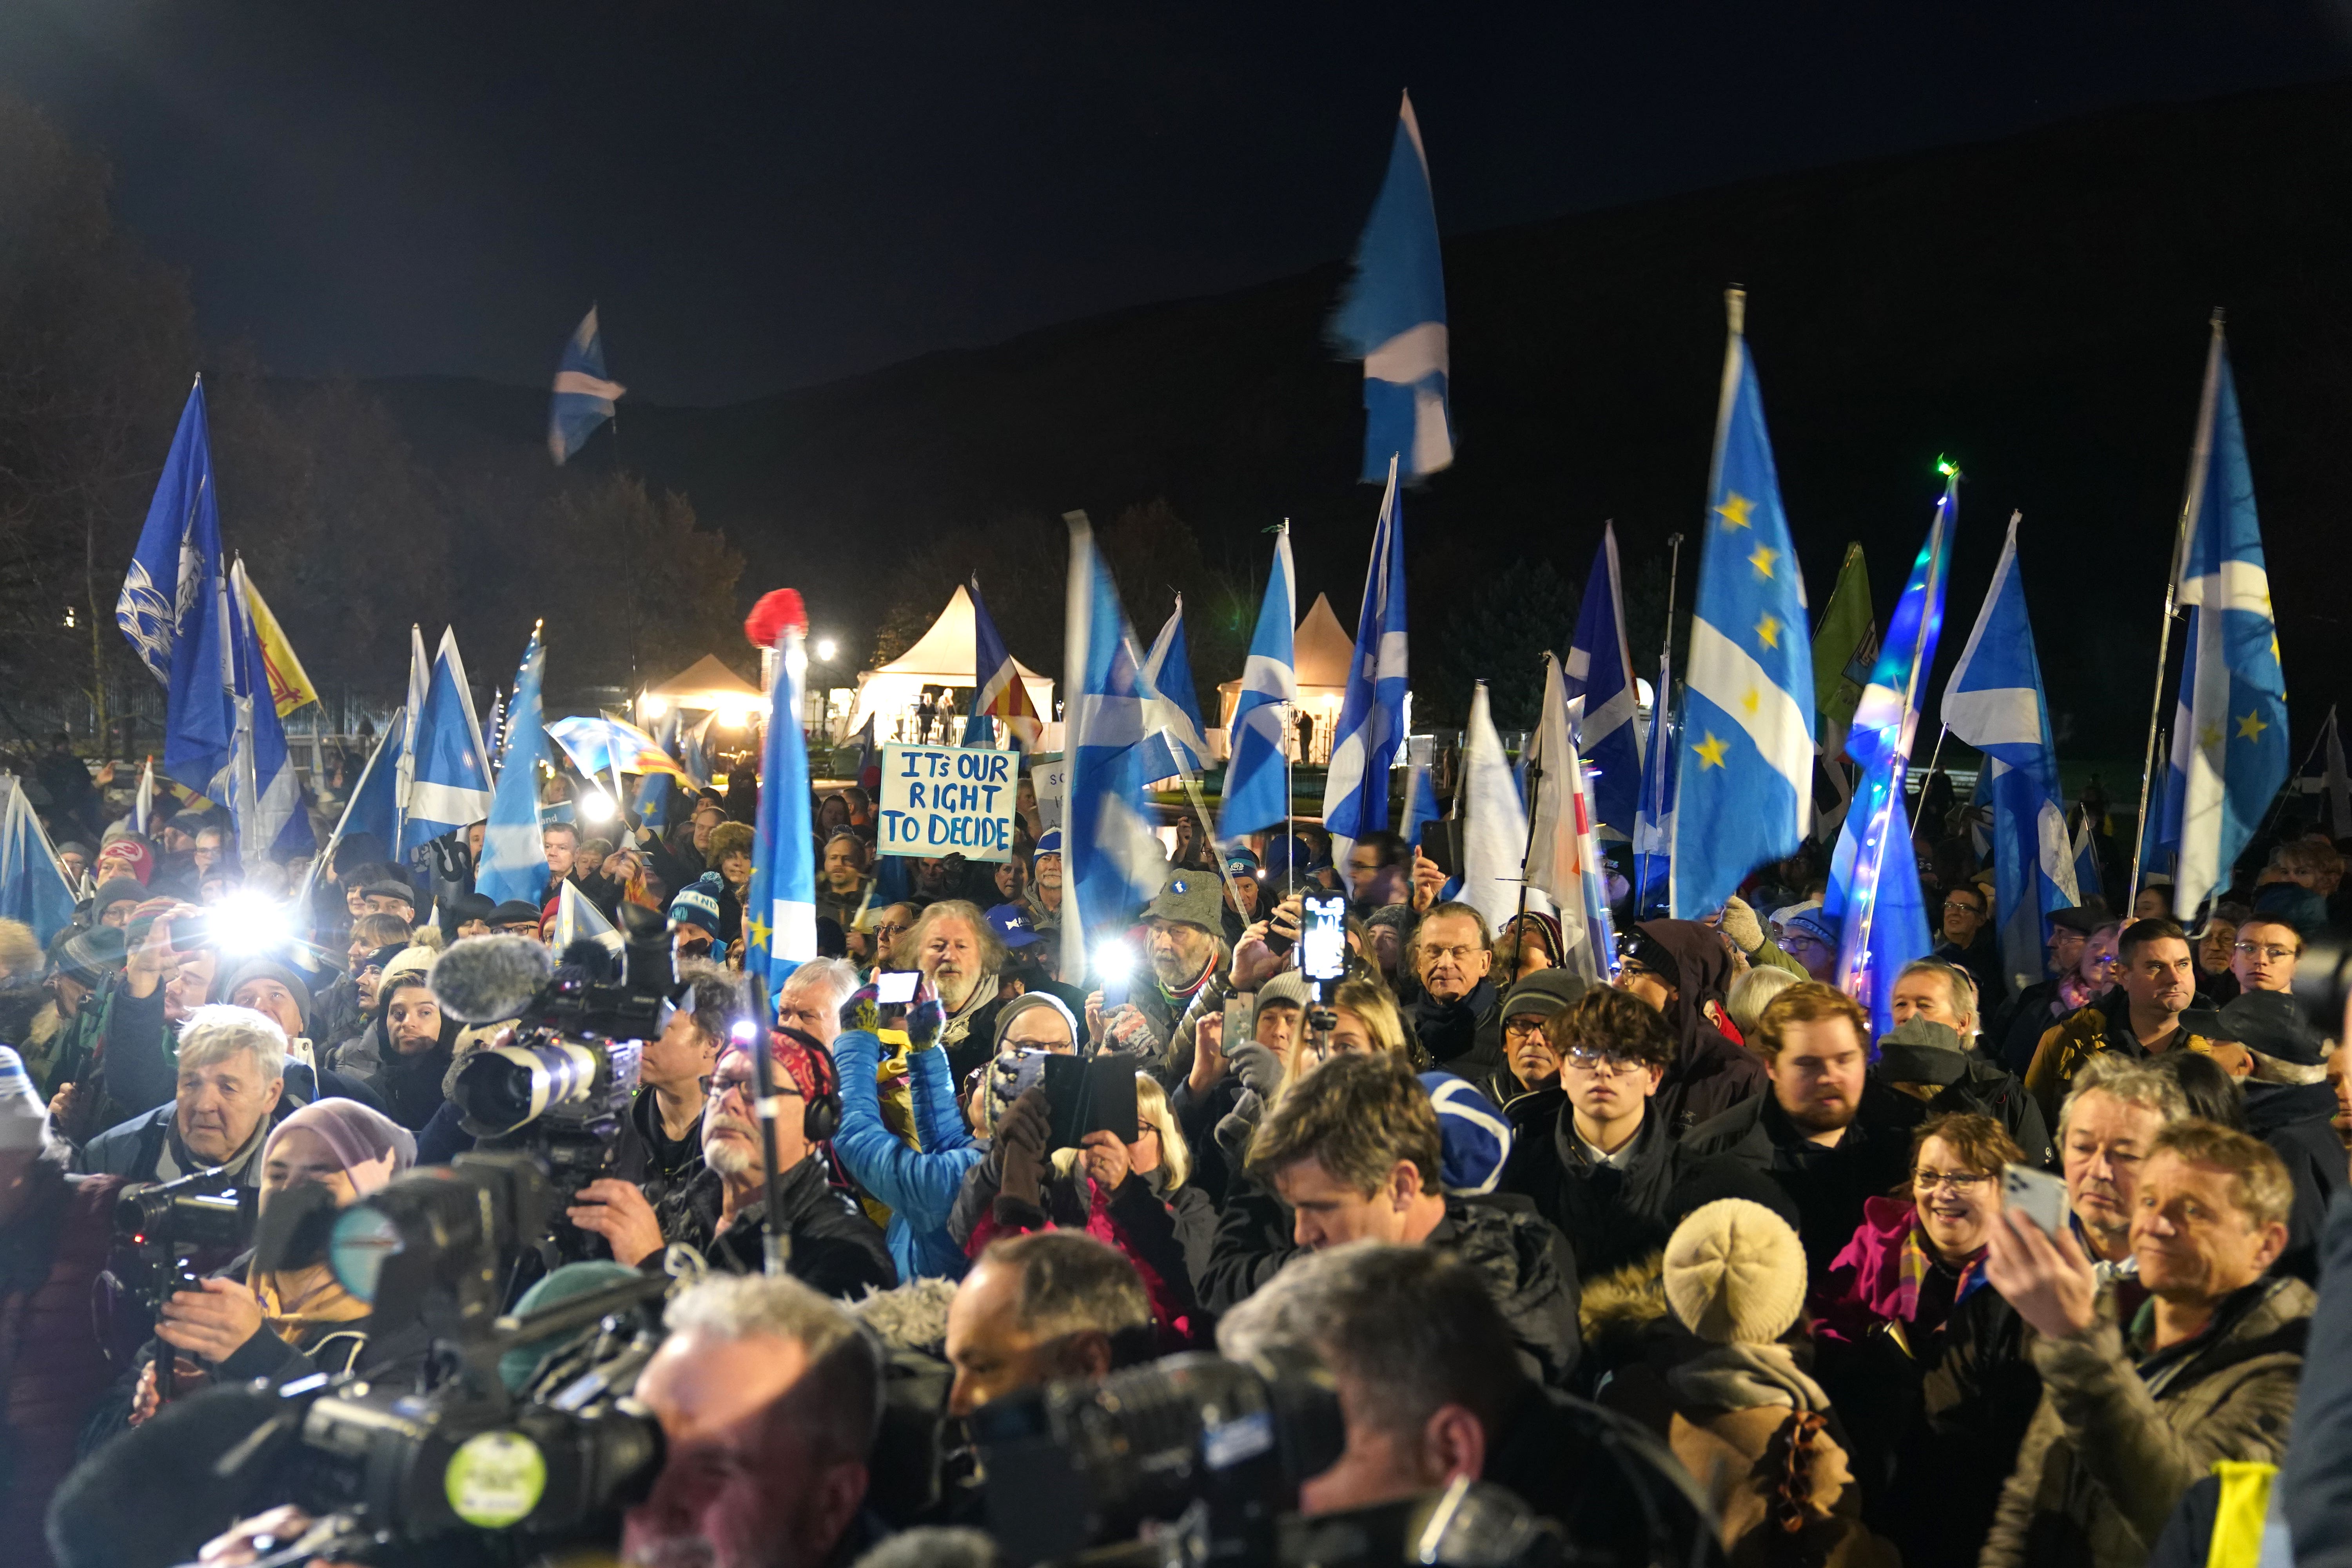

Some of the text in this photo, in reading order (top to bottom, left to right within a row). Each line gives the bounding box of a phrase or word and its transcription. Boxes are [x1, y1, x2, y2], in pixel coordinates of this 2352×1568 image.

[957, 753, 1009, 782] OUR
[909, 782, 1002, 813] RIGHT
[882, 810, 1010, 851] TO DECIDE
